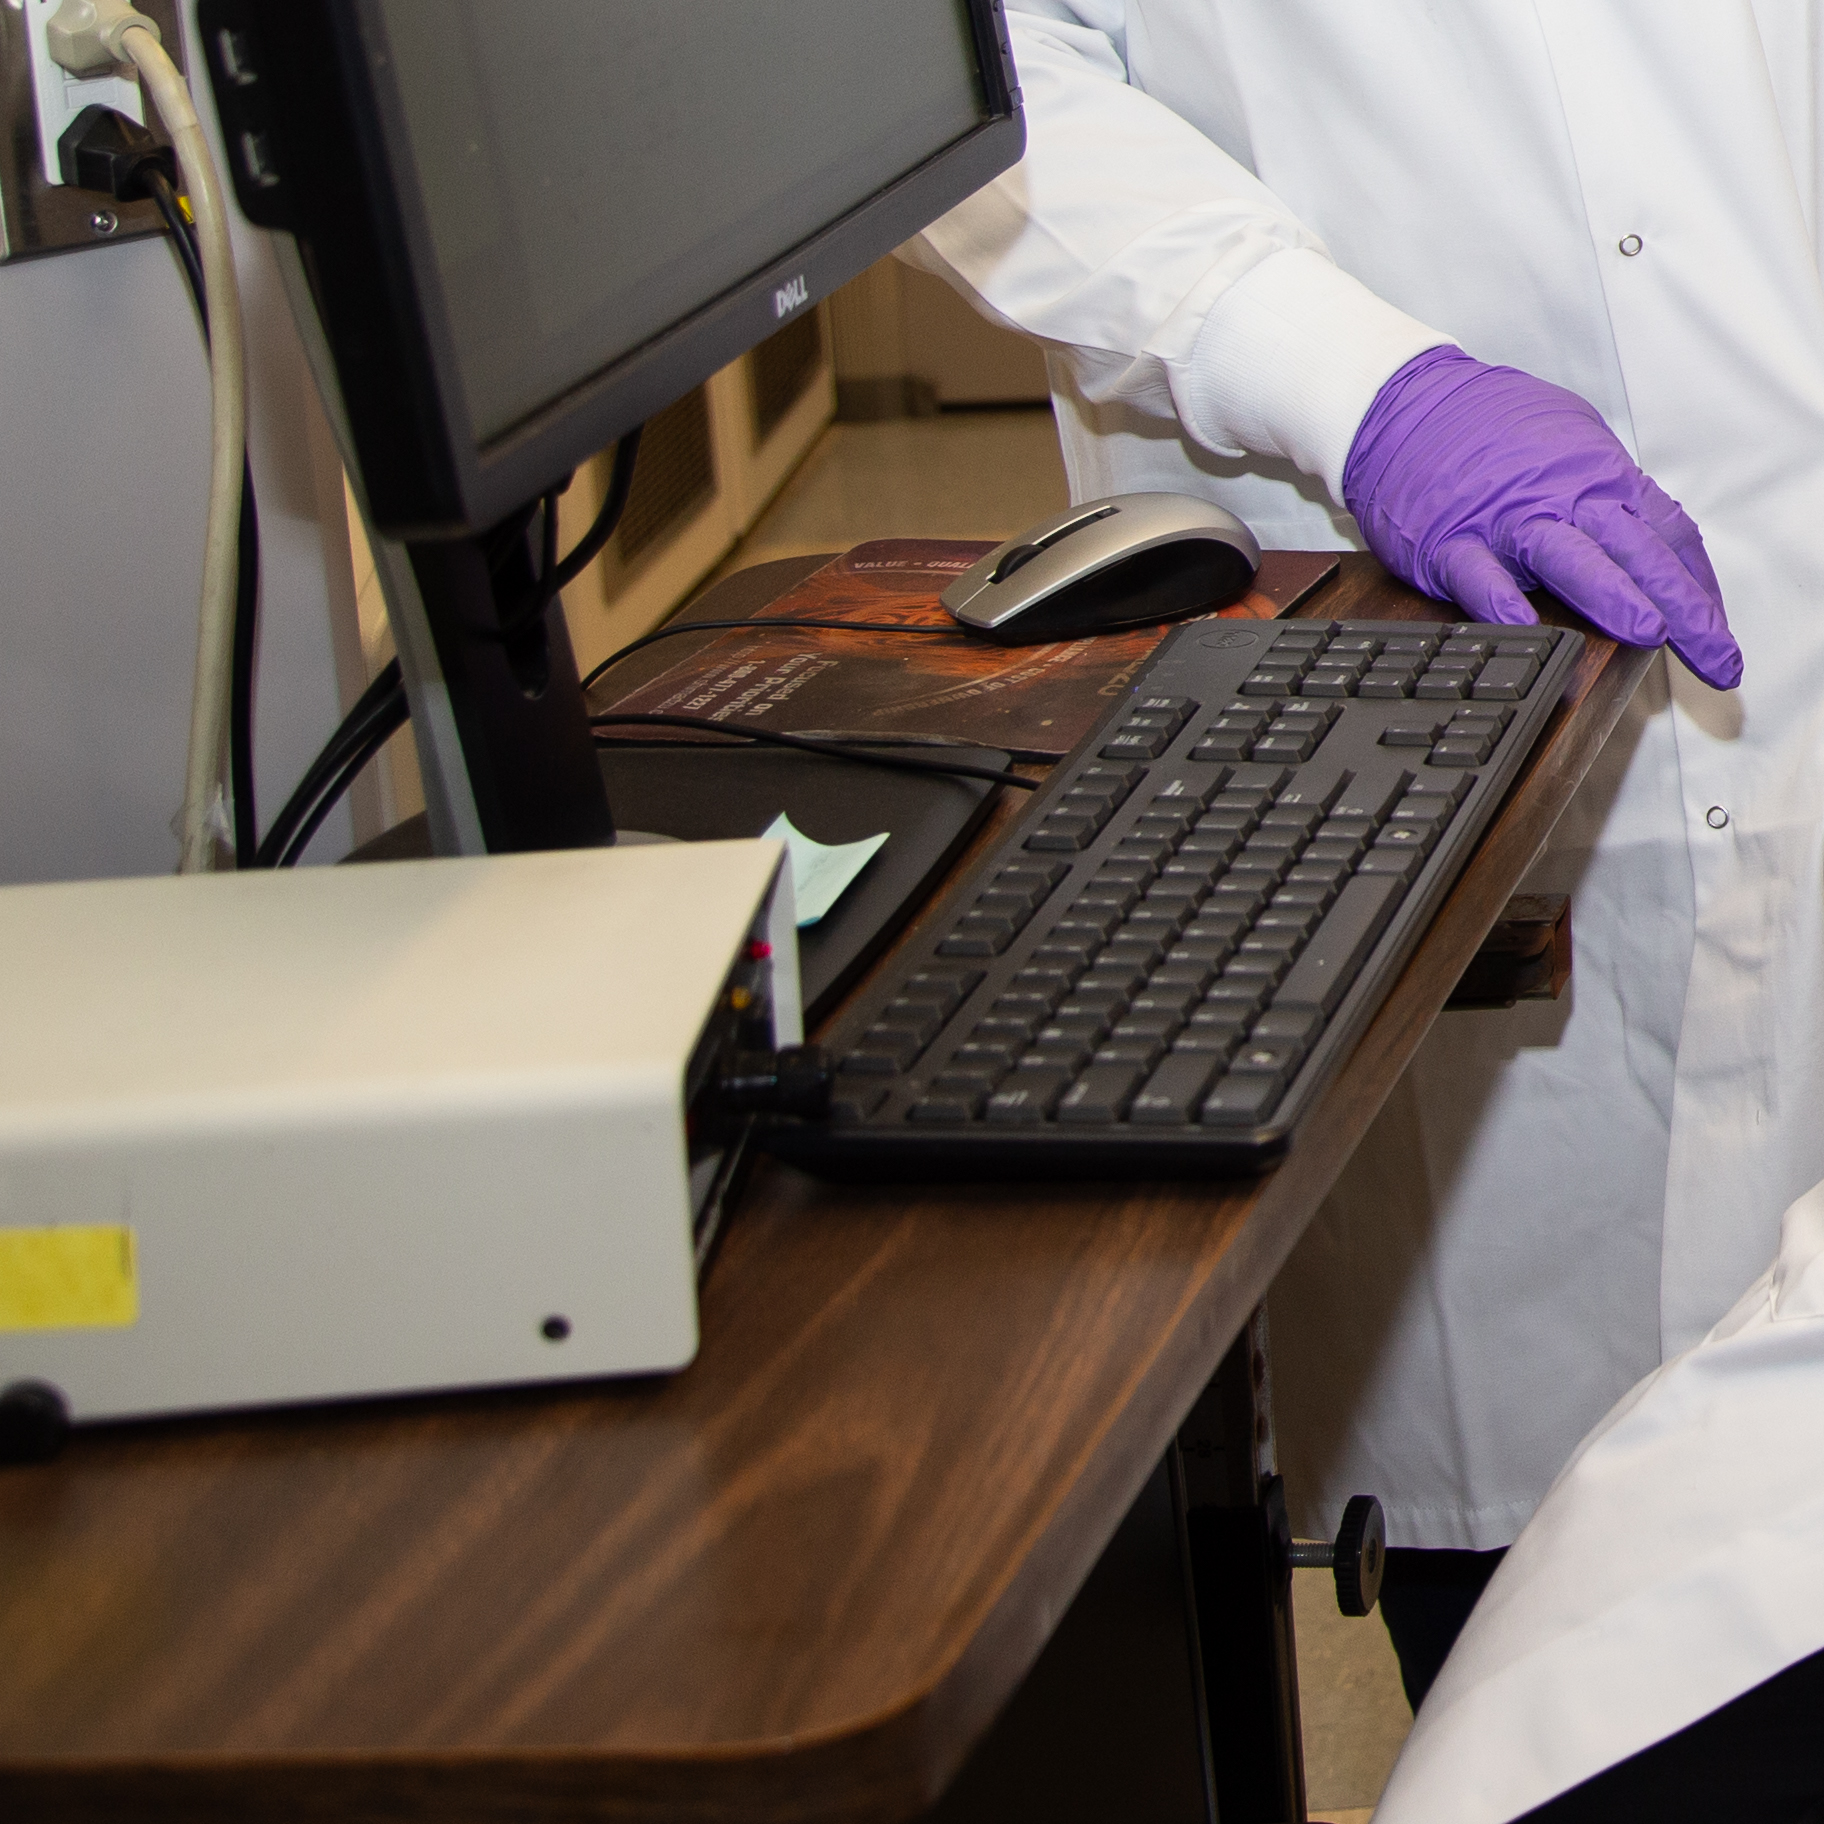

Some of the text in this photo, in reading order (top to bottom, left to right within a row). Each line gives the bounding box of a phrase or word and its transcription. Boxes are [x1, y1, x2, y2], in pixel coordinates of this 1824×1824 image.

[775, 273, 809, 319] DELL
[854, 560, 909, 569] VALUE
[774, 651, 823, 675] Your
[745, 659, 839, 717] Focused on
